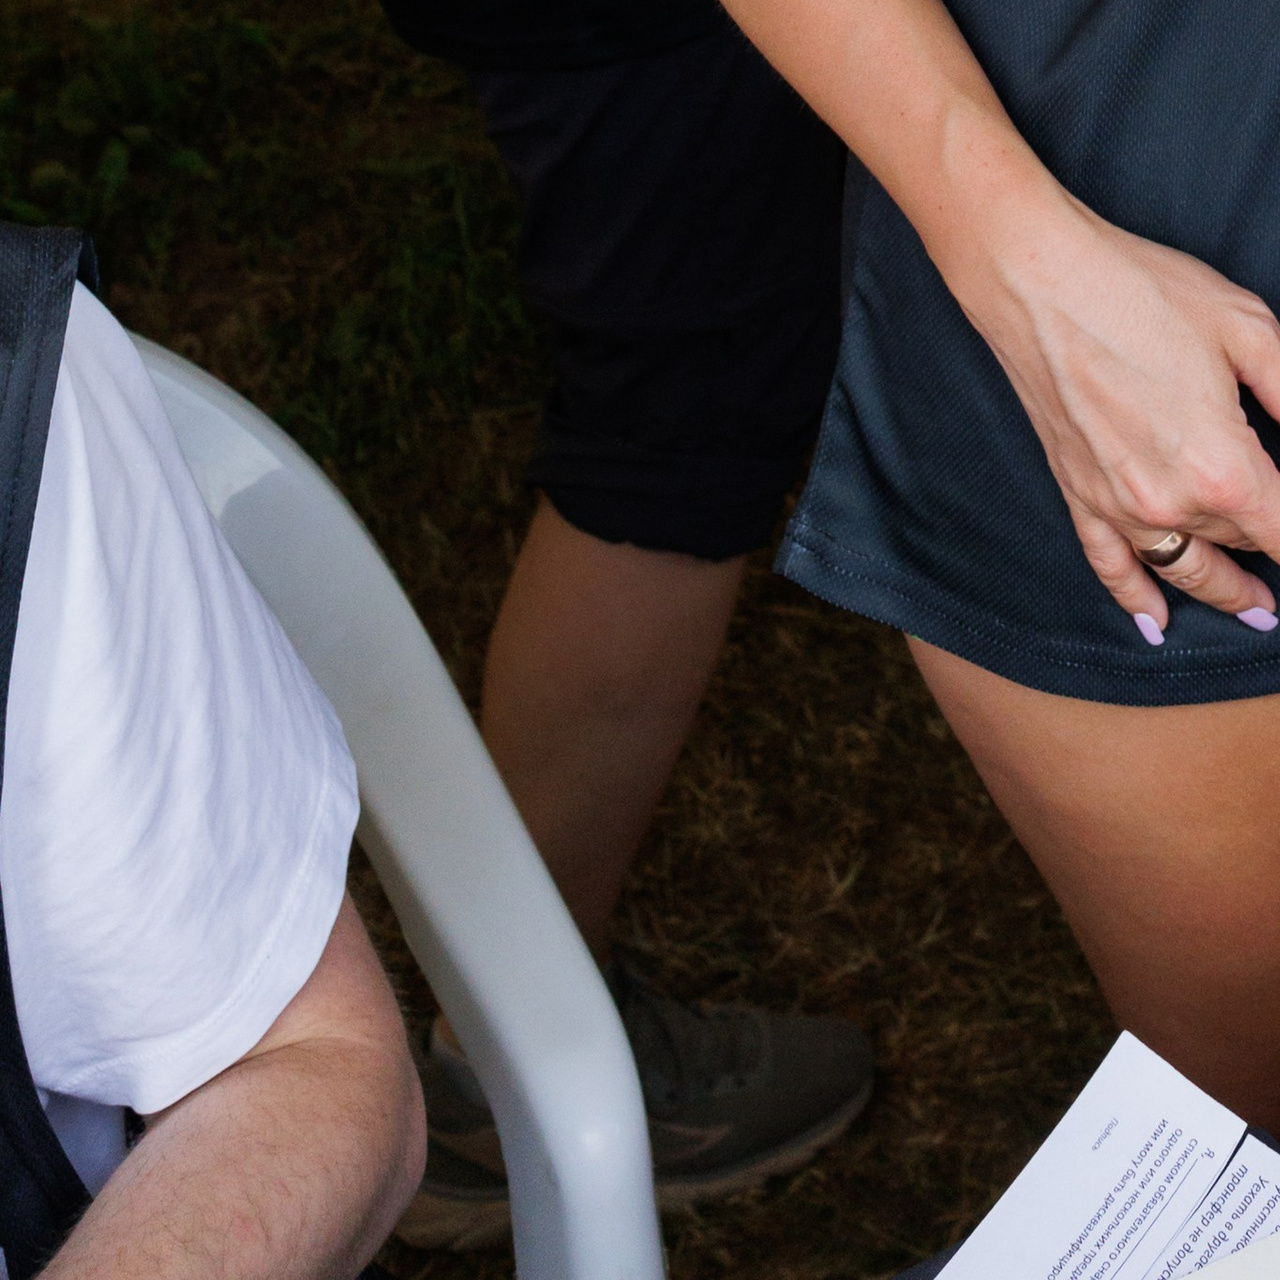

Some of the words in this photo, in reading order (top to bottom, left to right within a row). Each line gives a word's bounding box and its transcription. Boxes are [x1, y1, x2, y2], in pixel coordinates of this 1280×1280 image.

[1091, 1117, 1119, 1152] Подпись
[1151, 1118, 1169, 1141] или
[1131, 1140, 1154, 1169] могу
[1154, 1128, 1183, 1168] одного
[1164, 1138, 1199, 1185] списком
[1113, 1168, 1137, 1194] быть
[1139, 1167, 1157, 1190] или
[1200, 1164, 1249, 1228] трансфер
[1094, 1190, 1141, 1251] нескольких
[1108, 1184, 1167, 1262] обязательного
[1188, 1226, 1204, 1243] не
